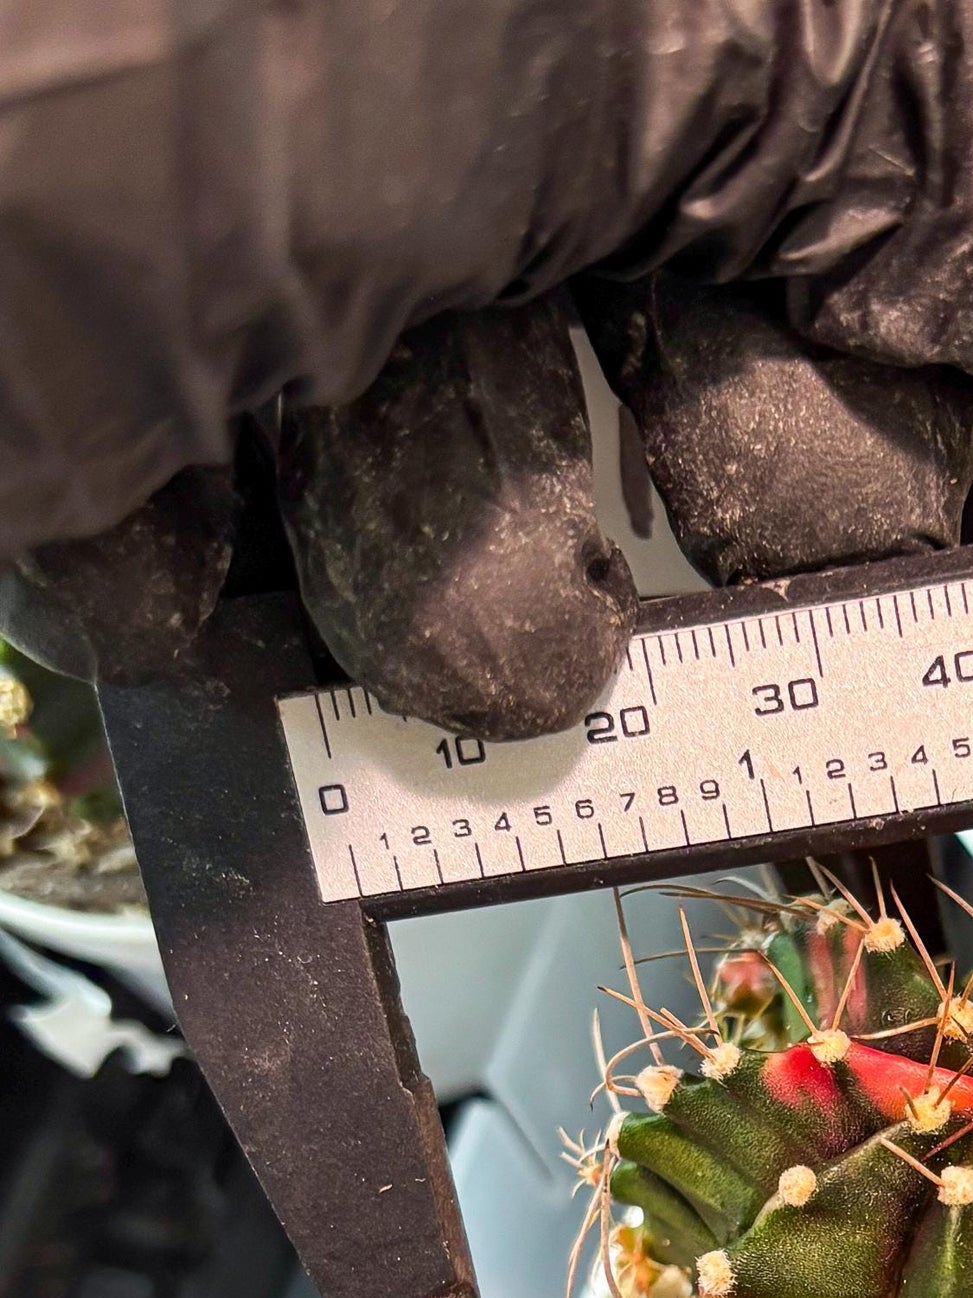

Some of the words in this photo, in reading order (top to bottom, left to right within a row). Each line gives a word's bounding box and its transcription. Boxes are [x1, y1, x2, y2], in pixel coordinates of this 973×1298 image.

[317, 783, 350, 816] 0
[435, 735, 486, 769] 10
[584, 704, 651, 745] 20
[751, 677, 820, 717] 30
[379, 832, 391, 850] 1
[410, 825, 433, 846] 2
[451, 818, 473, 838] 3
[493, 811, 513, 832] 4
[532, 804, 553, 827] 5
[574, 798, 595, 821] 6
[618, 791, 636, 813] 7
[656, 784, 680, 807] 8
[699, 778, 721, 802] 9
[737, 748, 756, 781] 1
[792, 765, 803, 785] 1
[825, 758, 847, 780] 2
[867, 751, 888, 772] 3
[910, 744, 929, 766] 4
[951, 736, 972, 759] 5
